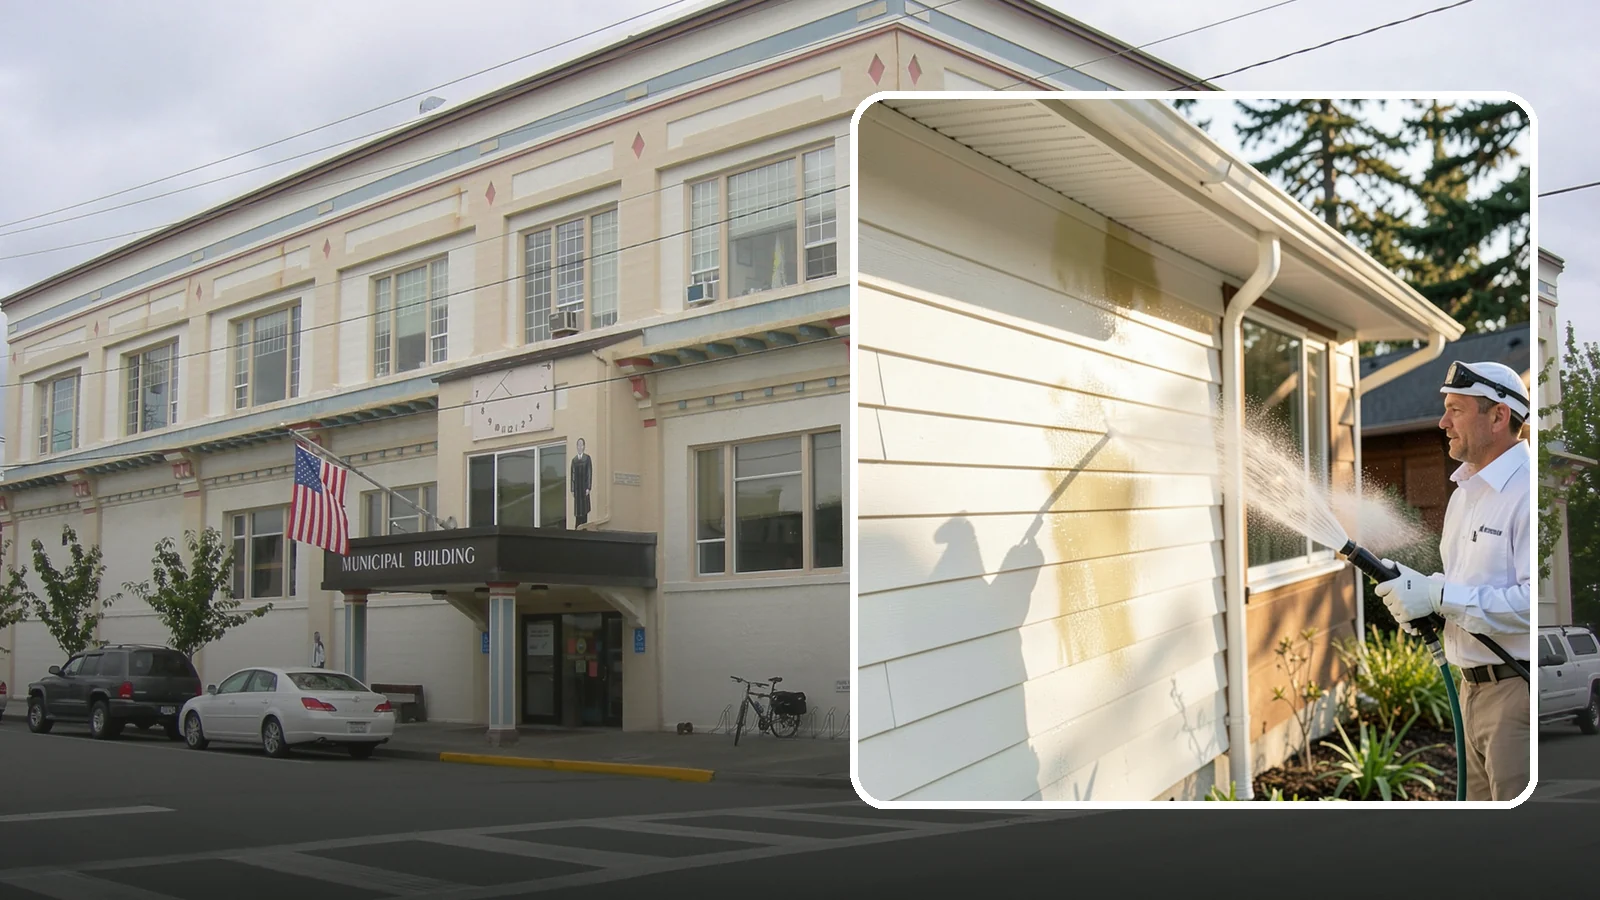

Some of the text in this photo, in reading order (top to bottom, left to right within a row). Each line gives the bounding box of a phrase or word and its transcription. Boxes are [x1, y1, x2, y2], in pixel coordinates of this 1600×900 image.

[546, 362, 552, 370] 6
[476, 390, 479, 398] 7
[481, 407, 484, 415] 8
[488, 417, 492, 426] 9
[529, 414, 533, 422] 3
[342, 546, 475, 572] MUNICIPAL BUILDING
